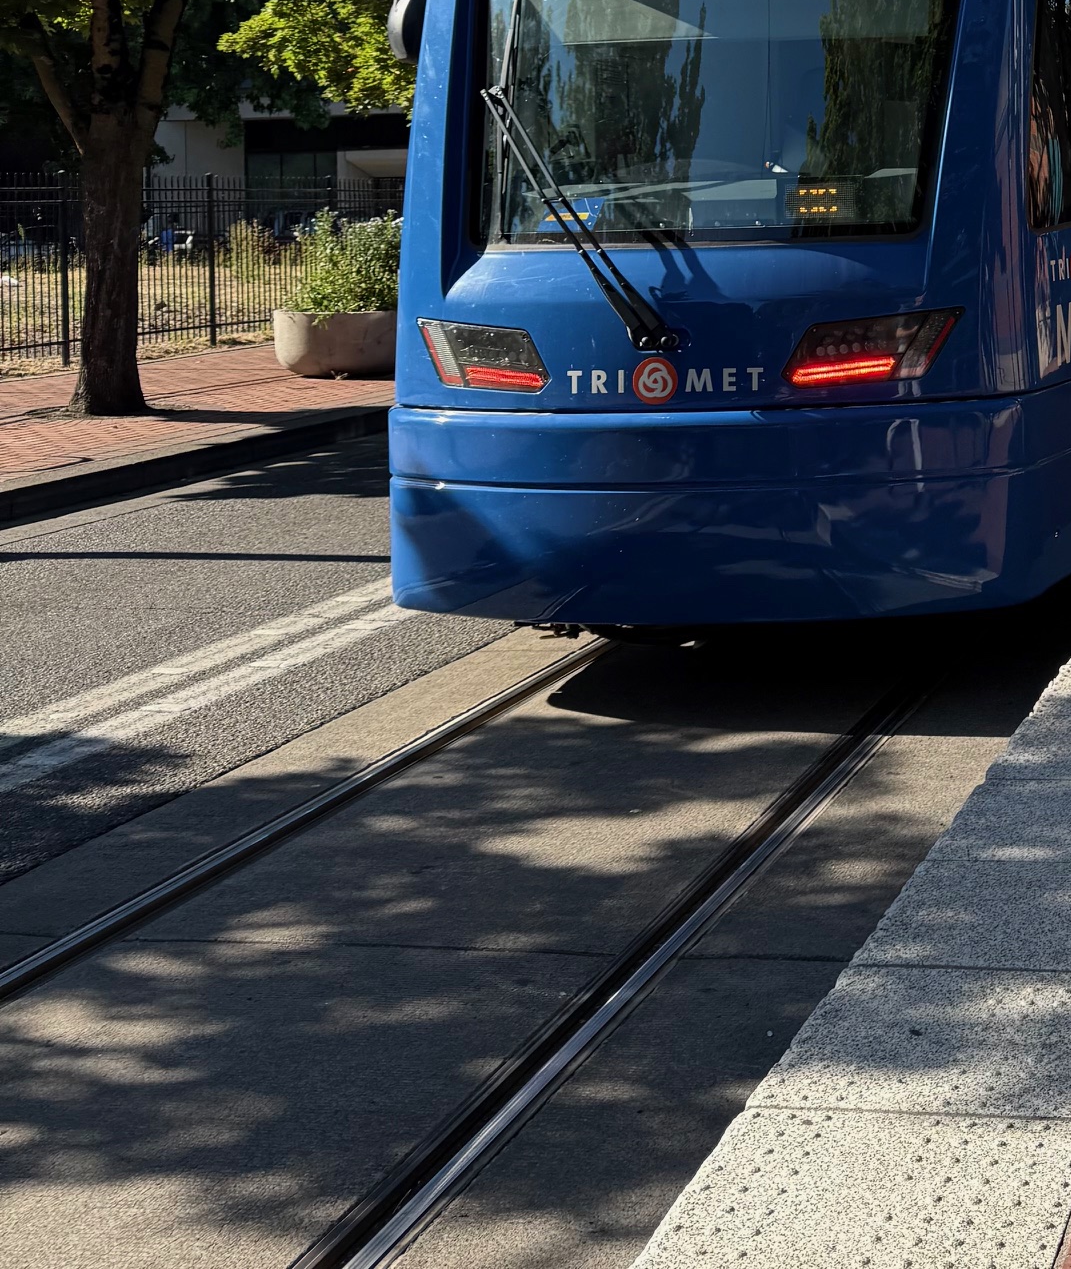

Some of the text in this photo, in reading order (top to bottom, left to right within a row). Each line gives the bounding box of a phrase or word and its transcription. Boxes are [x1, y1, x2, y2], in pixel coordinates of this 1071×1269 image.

[1050, 258, 1070, 281] TRI
[566, 367, 764, 394] TRI MET
